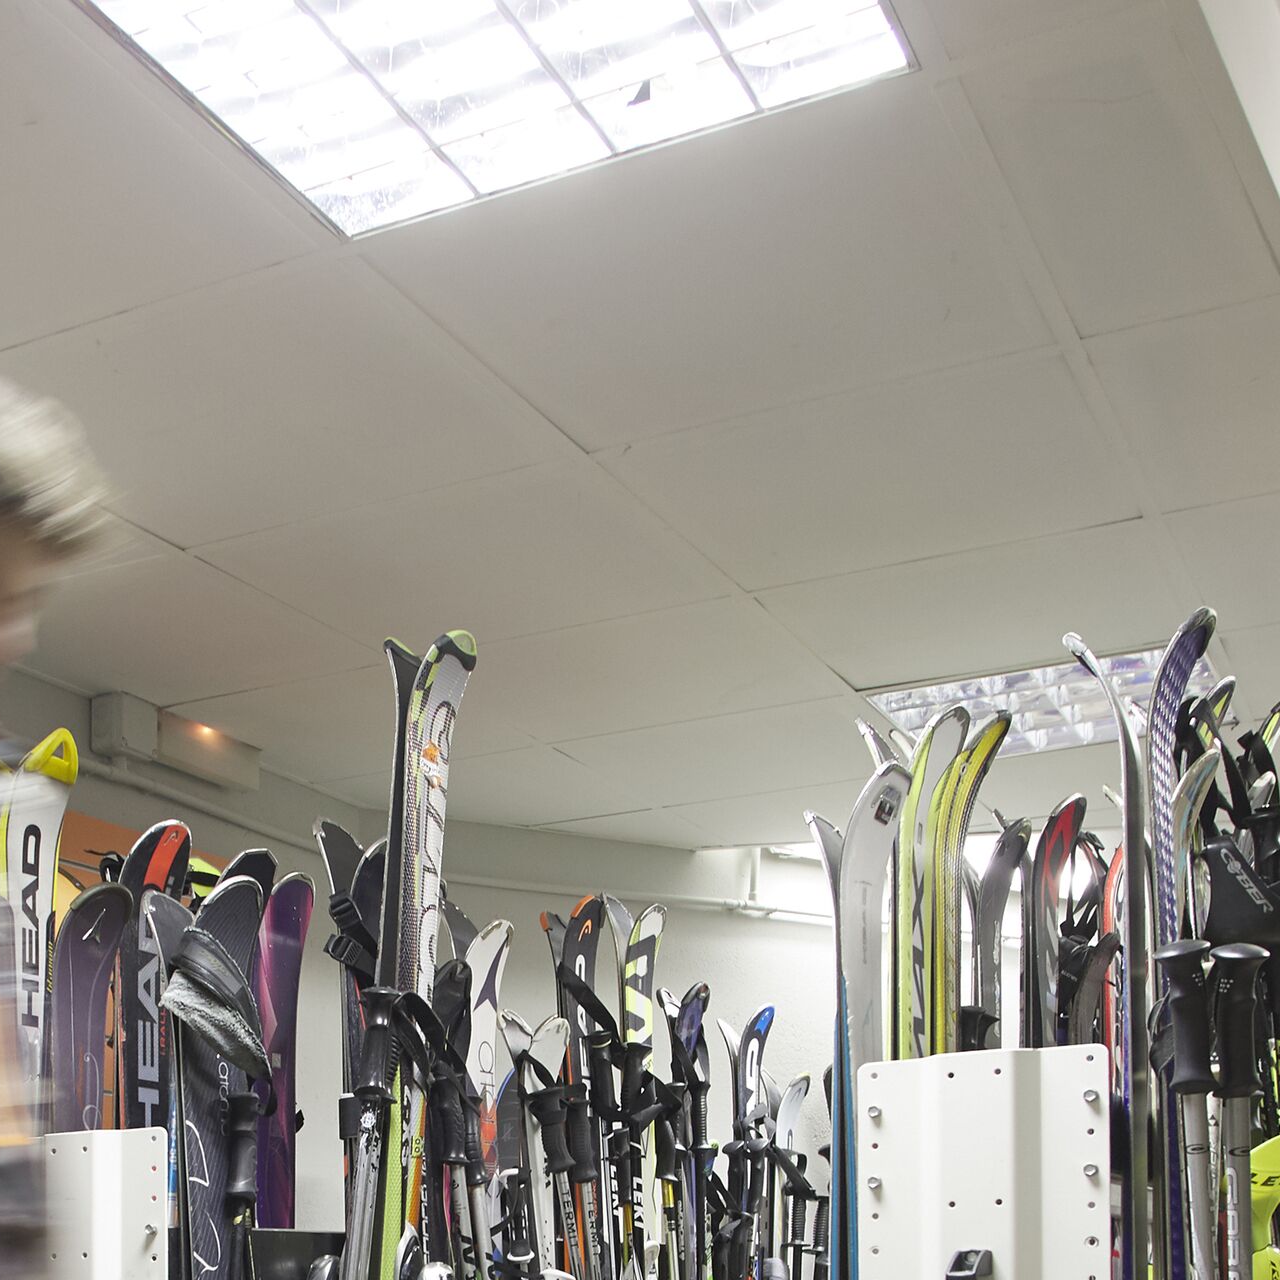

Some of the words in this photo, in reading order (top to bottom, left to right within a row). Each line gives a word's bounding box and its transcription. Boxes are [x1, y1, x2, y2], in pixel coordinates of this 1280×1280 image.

[1219, 848, 1274, 913] COBER
[21, 823, 42, 1030] HEAD
[609, 1164, 620, 1217] LEKI
[632, 1176, 645, 1230] LEKI
